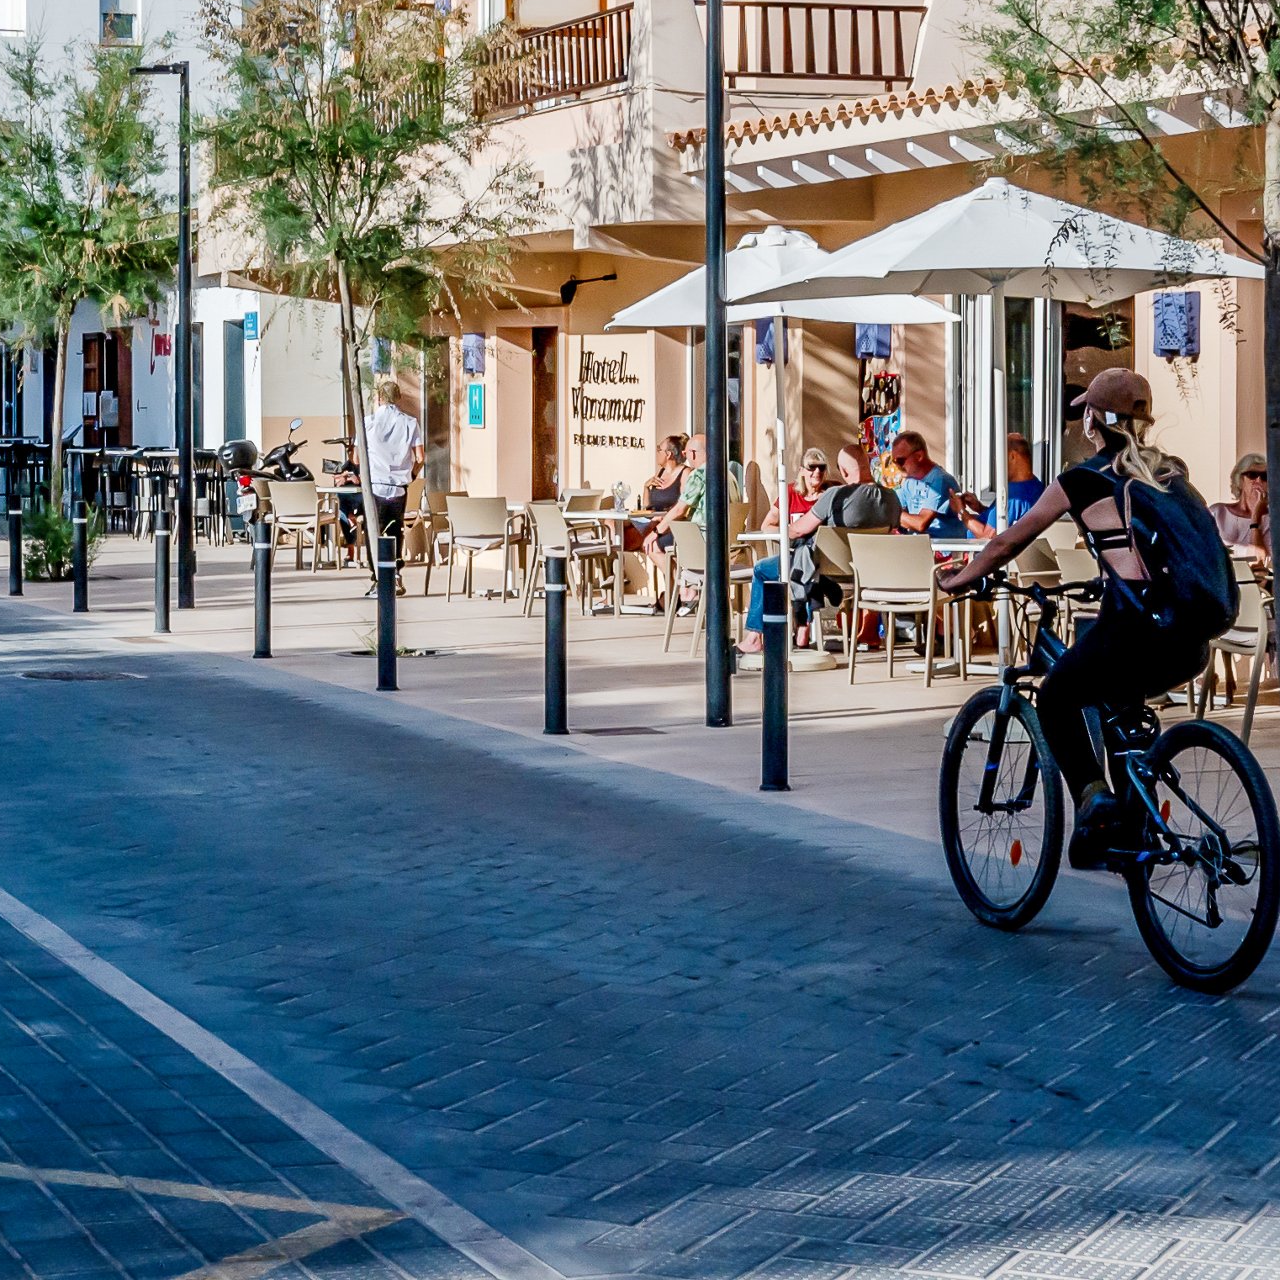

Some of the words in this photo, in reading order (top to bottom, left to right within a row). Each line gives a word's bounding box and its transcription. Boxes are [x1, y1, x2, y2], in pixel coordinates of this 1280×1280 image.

[472, 388, 480, 410] H
[571, 386, 645, 422] Voramar
[573, 433, 646, 449] FORMENTERA
